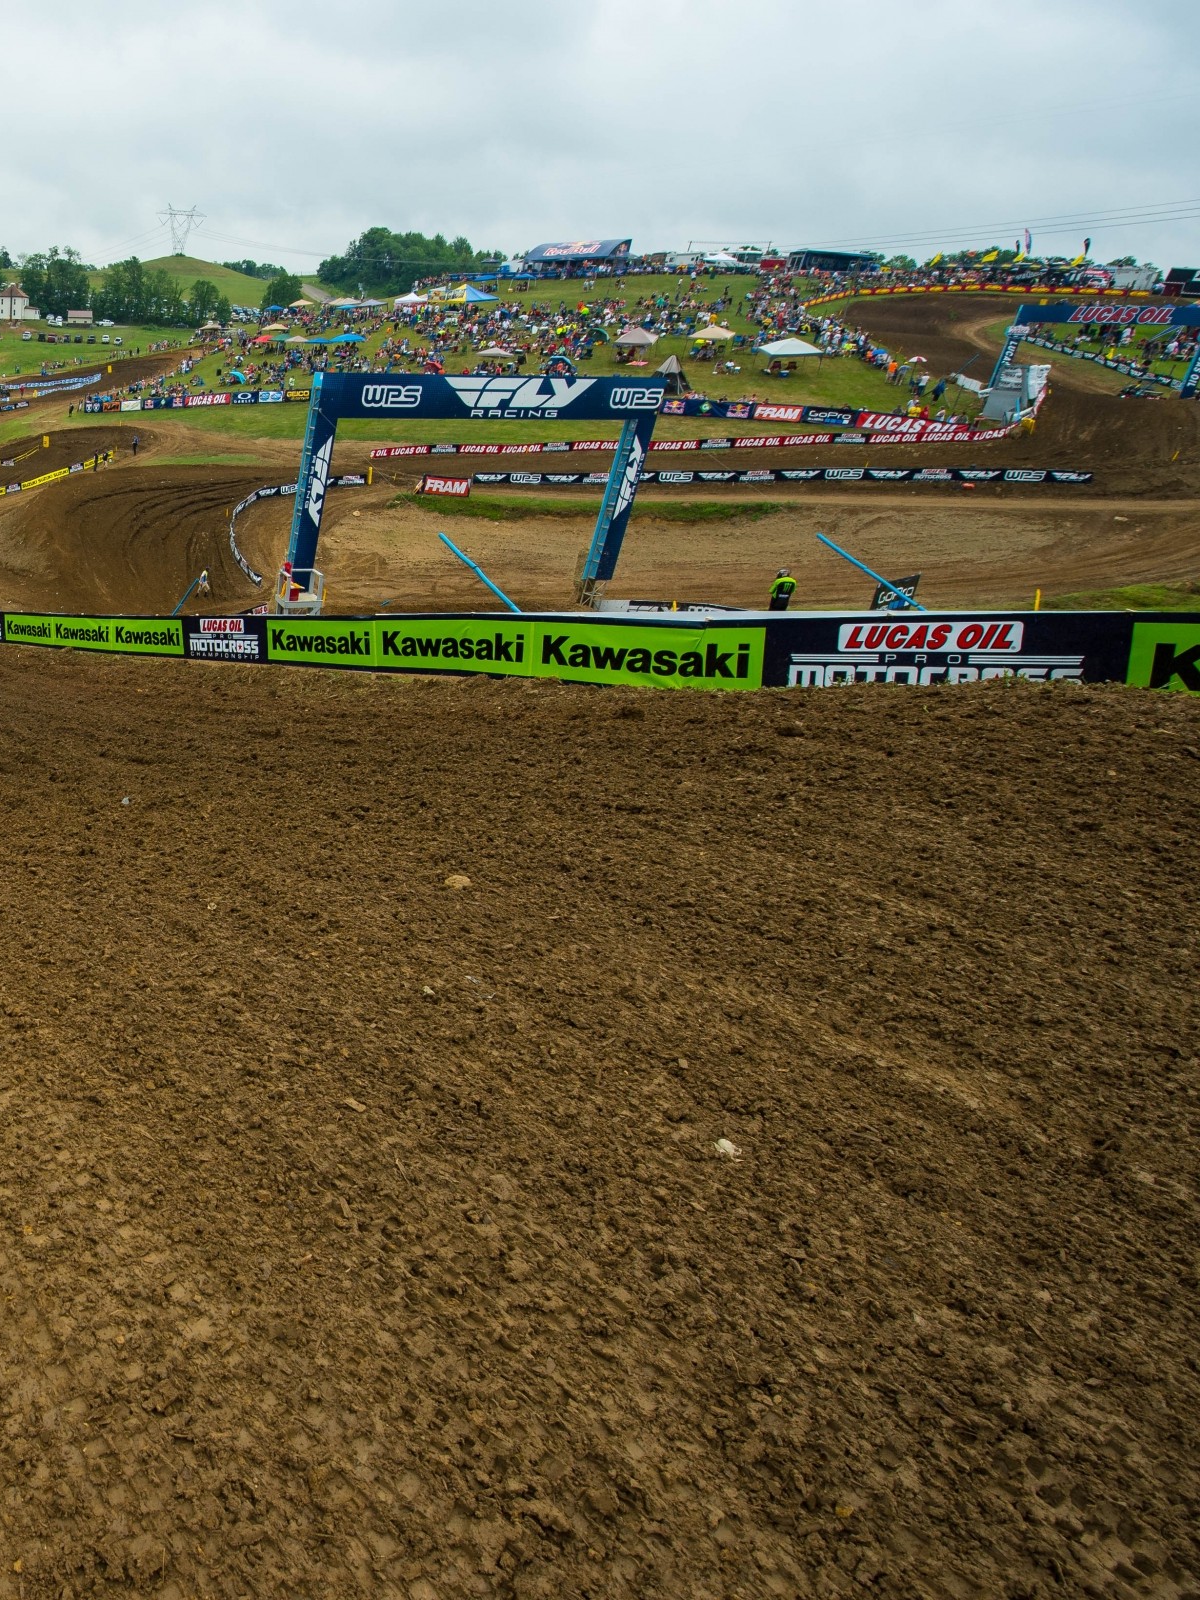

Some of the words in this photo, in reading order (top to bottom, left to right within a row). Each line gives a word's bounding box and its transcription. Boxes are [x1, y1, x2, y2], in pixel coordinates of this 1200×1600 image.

[1068, 306, 1138, 324] LUCAS
[1137, 307, 1176, 324] OIL
[286, 390, 310, 398] GEICO
[362, 385, 423, 408] WPS
[445, 376, 598, 408] FLY
[188, 395, 212, 405] LUCAS
[213, 393, 227, 404] OIL
[609, 388, 664, 409] WPS
[470, 409, 558, 418] RACING
[754, 407, 800, 419] FRAM
[809, 410, 852, 419] GoPro
[862, 414, 927, 433] LUCAS
[734, 439, 761, 447] LUCAS
[761, 437, 780, 446] OIL
[784, 436, 812, 444] LUCAS
[813, 434, 830, 443] OIL
[869, 433, 901, 443] LUCAS
[902, 432, 917, 442] OIL
[921, 432, 953, 442] LUCAS
[954, 431, 970, 441] OIL
[973, 429, 1005, 441] LUCAS
[460, 445, 485, 453] LUCAS
[486, 445, 500, 453] OIL
[502, 445, 527, 453] LUCAS
[528, 444, 541, 452] OIL
[573, 442, 600, 450] LUCAS
[653, 442, 681, 450] LUCAS
[682, 440, 698, 449] OIL
[376, 449, 388, 457] OIL
[390, 447, 414, 456] LUCAS
[415, 446, 428, 454] OIL
[509, 473, 541, 483] WPS
[658, 472, 694, 483] WPS
[825, 469, 865, 480] WPS
[1004, 470, 1047, 481] WPS
[424, 479, 468, 494] FRAM
[202, 619, 226, 632] LUCAS
[227, 619, 243, 632] OIL
[7, 619, 51, 638] Kawasaki
[55, 622, 109, 643] Kawasaki
[115, 627, 180, 646] Kawasaki
[844, 624, 952, 650] LUCAS
[956, 624, 1015, 649] OIL
[190, 639, 258, 654] MOTOCROSS
[190, 651, 260, 660] CHAMPIONSHIP
[272, 628, 370, 656] Kawasaki
[382, 630, 524, 663] Kawasaki
[542, 634, 750, 679] Kawasaki
[885, 654, 962, 664] PRO
